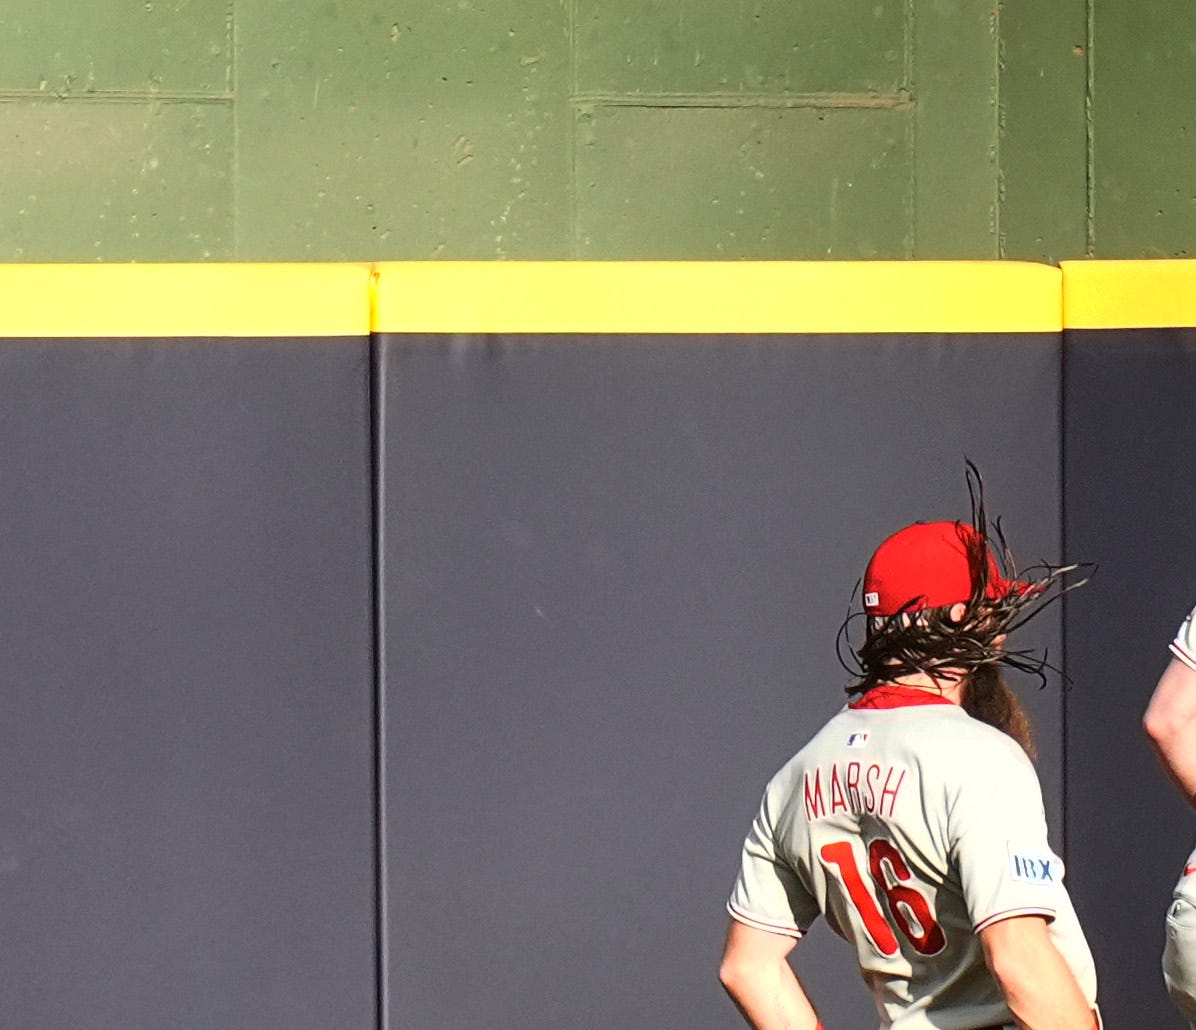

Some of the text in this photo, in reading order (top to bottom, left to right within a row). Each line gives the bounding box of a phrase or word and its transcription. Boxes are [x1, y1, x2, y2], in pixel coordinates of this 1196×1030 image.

[804, 761, 906, 822] MARSH
[819, 838, 948, 957] 16
[1013, 854, 1054, 882] IBX
